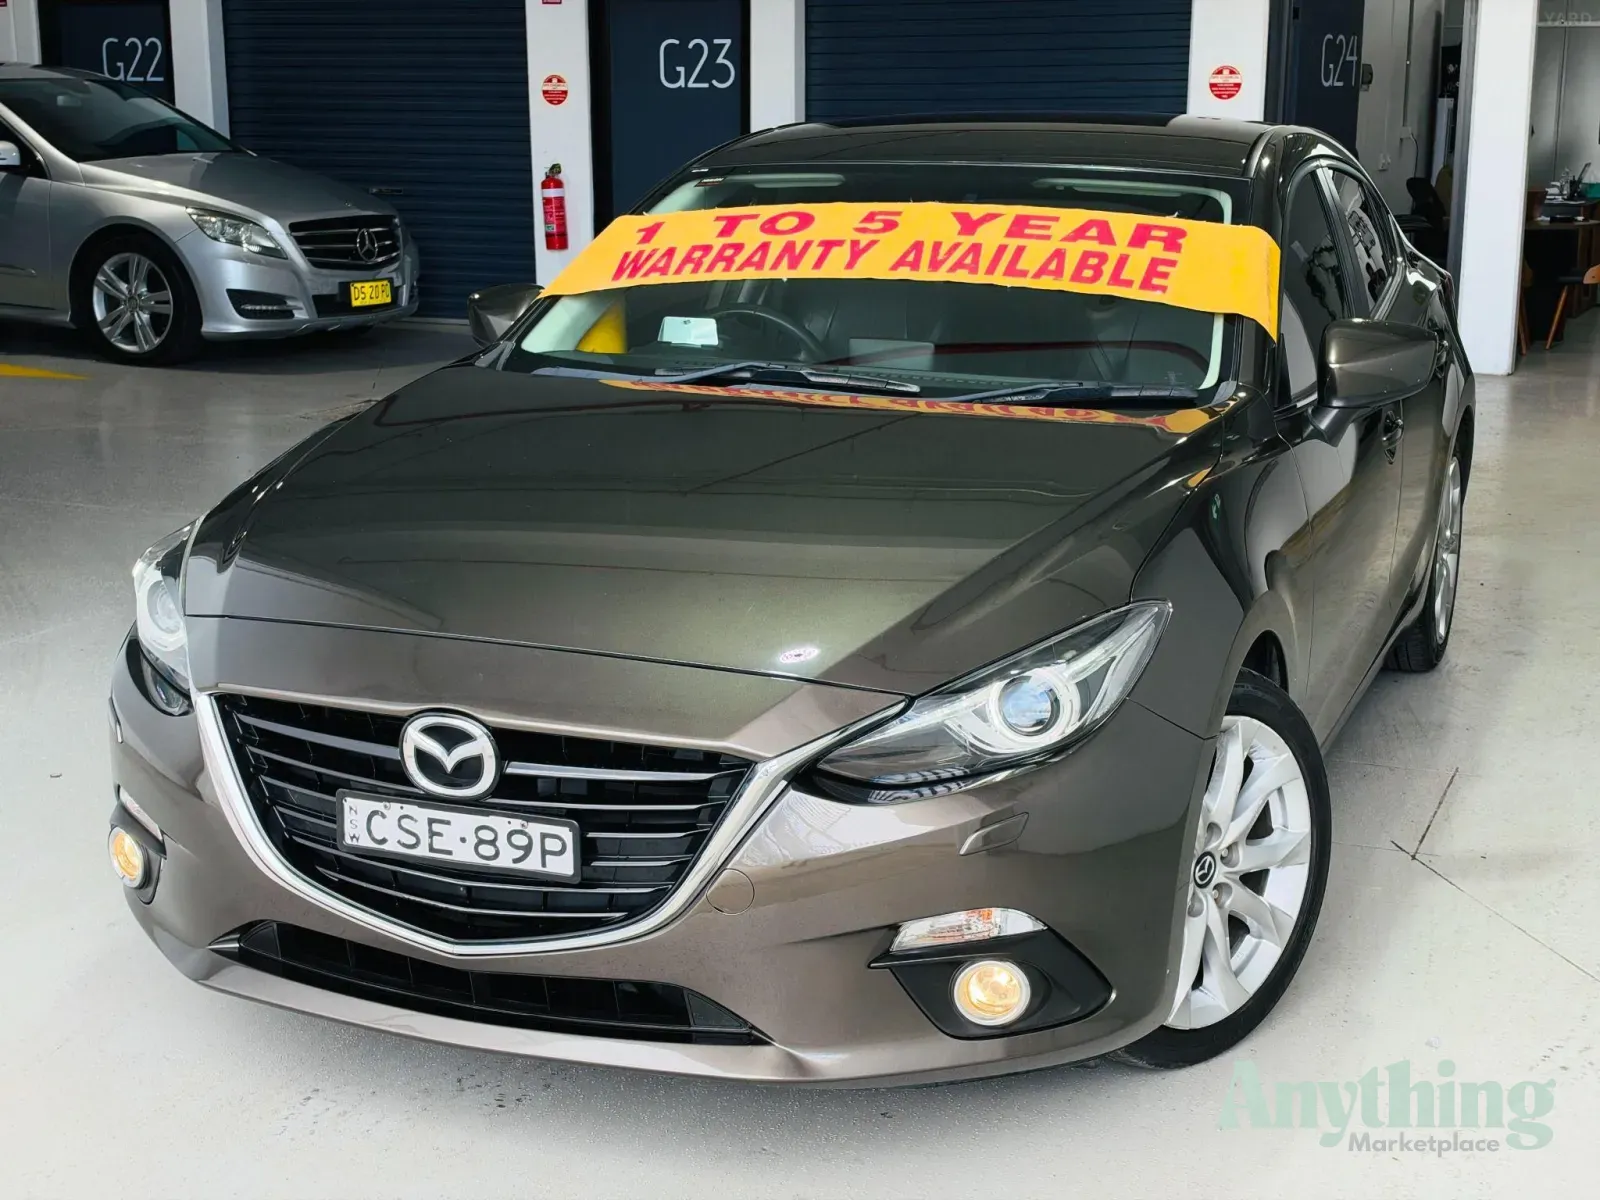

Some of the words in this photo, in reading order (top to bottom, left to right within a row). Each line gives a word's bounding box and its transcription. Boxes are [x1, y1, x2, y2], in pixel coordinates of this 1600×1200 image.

[102, 37, 165, 82] G22
[659, 38, 736, 89] G23
[1321, 33, 1358, 87] G24
[637, 221, 664, 245] 1
[714, 211, 816, 239] TO
[853, 210, 902, 235] 5
[951, 211, 1189, 253] YEAR
[611, 238, 880, 283] WARRANTY
[888, 240, 1179, 294] AVAILABLE
